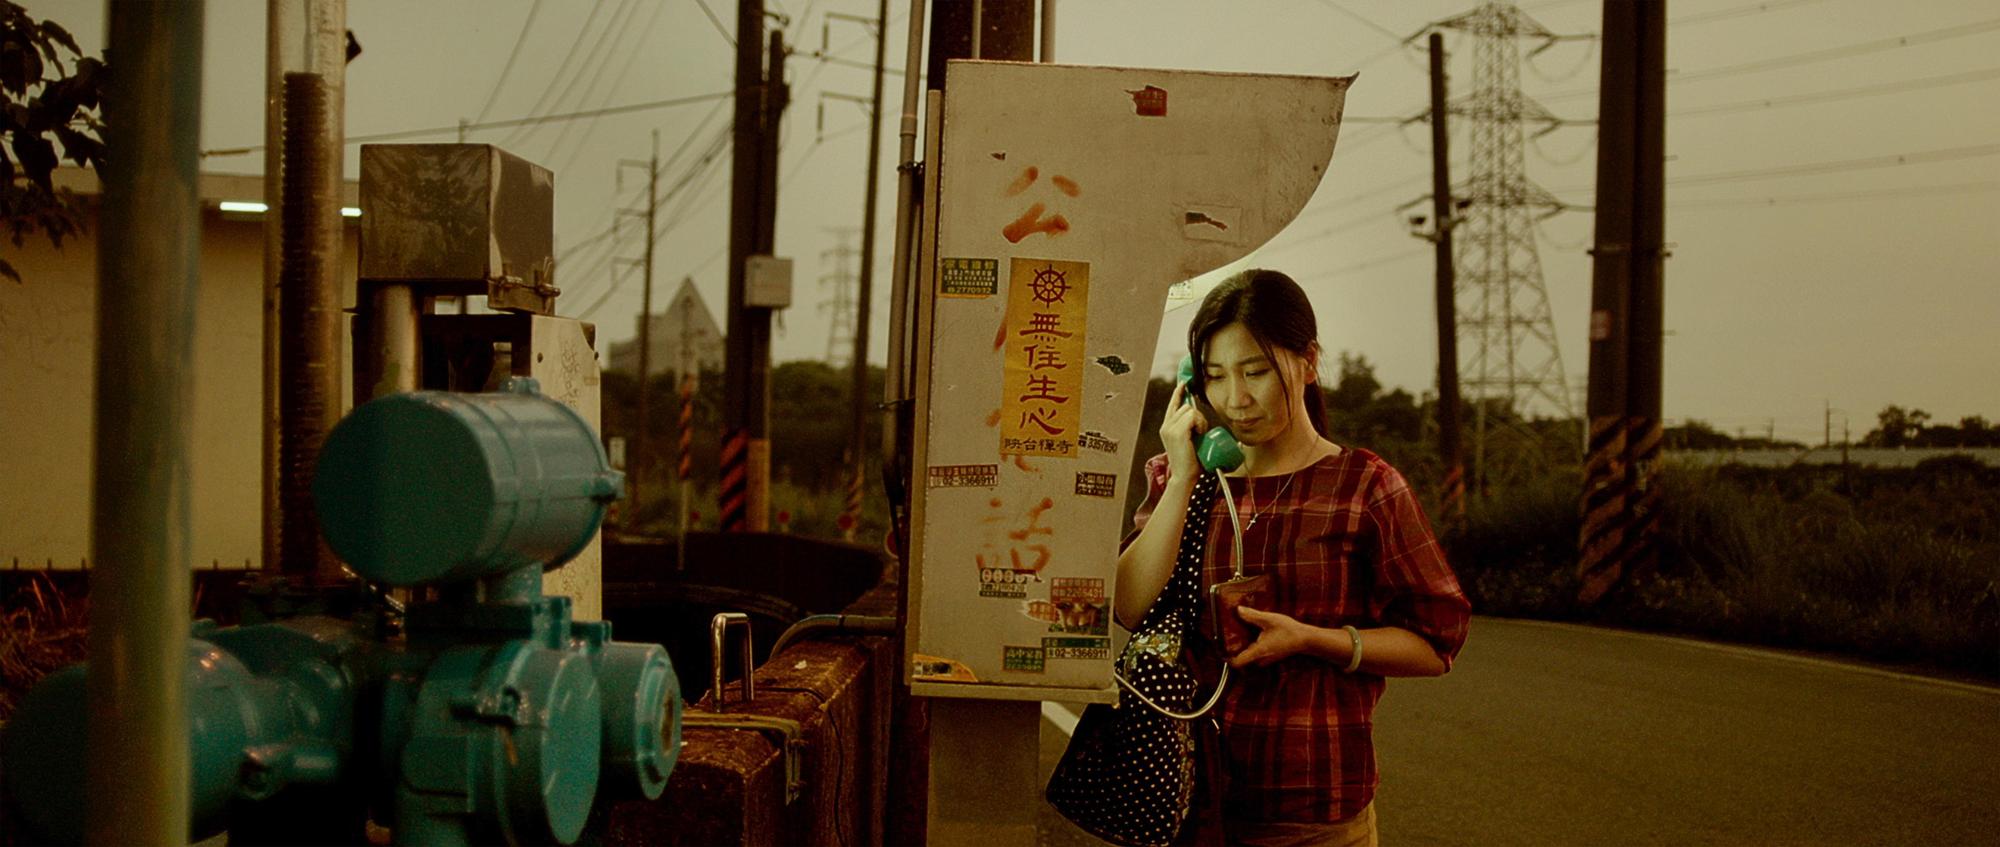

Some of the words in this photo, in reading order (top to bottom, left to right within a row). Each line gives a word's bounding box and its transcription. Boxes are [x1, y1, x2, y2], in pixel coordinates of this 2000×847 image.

[1019, 312, 1073, 436] 無住生心
[943, 475, 996, 486] 02-3366911
[1055, 648, 1107, 657] 02-3366911
